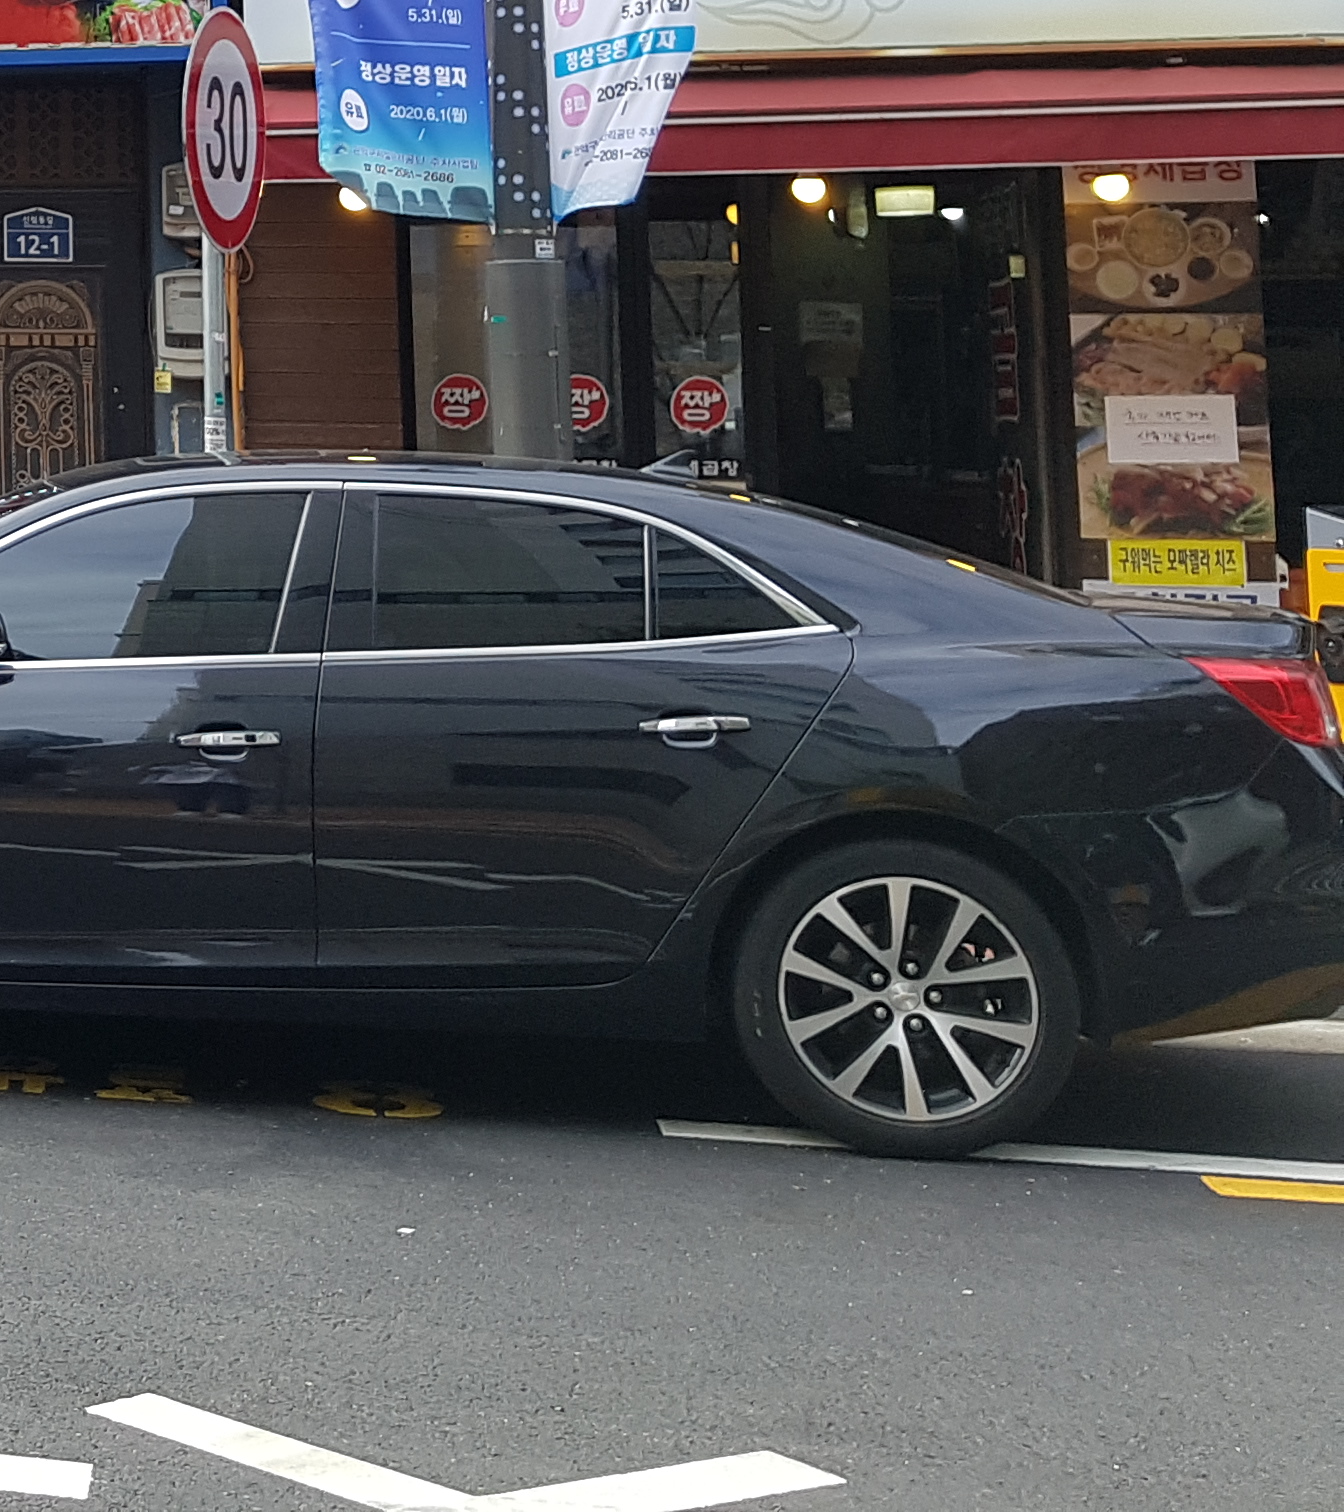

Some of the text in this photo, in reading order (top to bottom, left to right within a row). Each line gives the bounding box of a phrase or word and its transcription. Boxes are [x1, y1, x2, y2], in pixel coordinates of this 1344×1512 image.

[408, 9, 462, 25] 5.31.(일)
[565, 37, 629, 71] 정상운영
[359, 60, 467, 88] 정상운영 일자
[389, 104, 468, 124] 2020.6.1(월)
[205, 80, 248, 183] 30
[16, 234, 60, 255] 12-1
[1118, 547, 1163, 574] 구워먹는
[1214, 549, 1237, 575] 치즈
